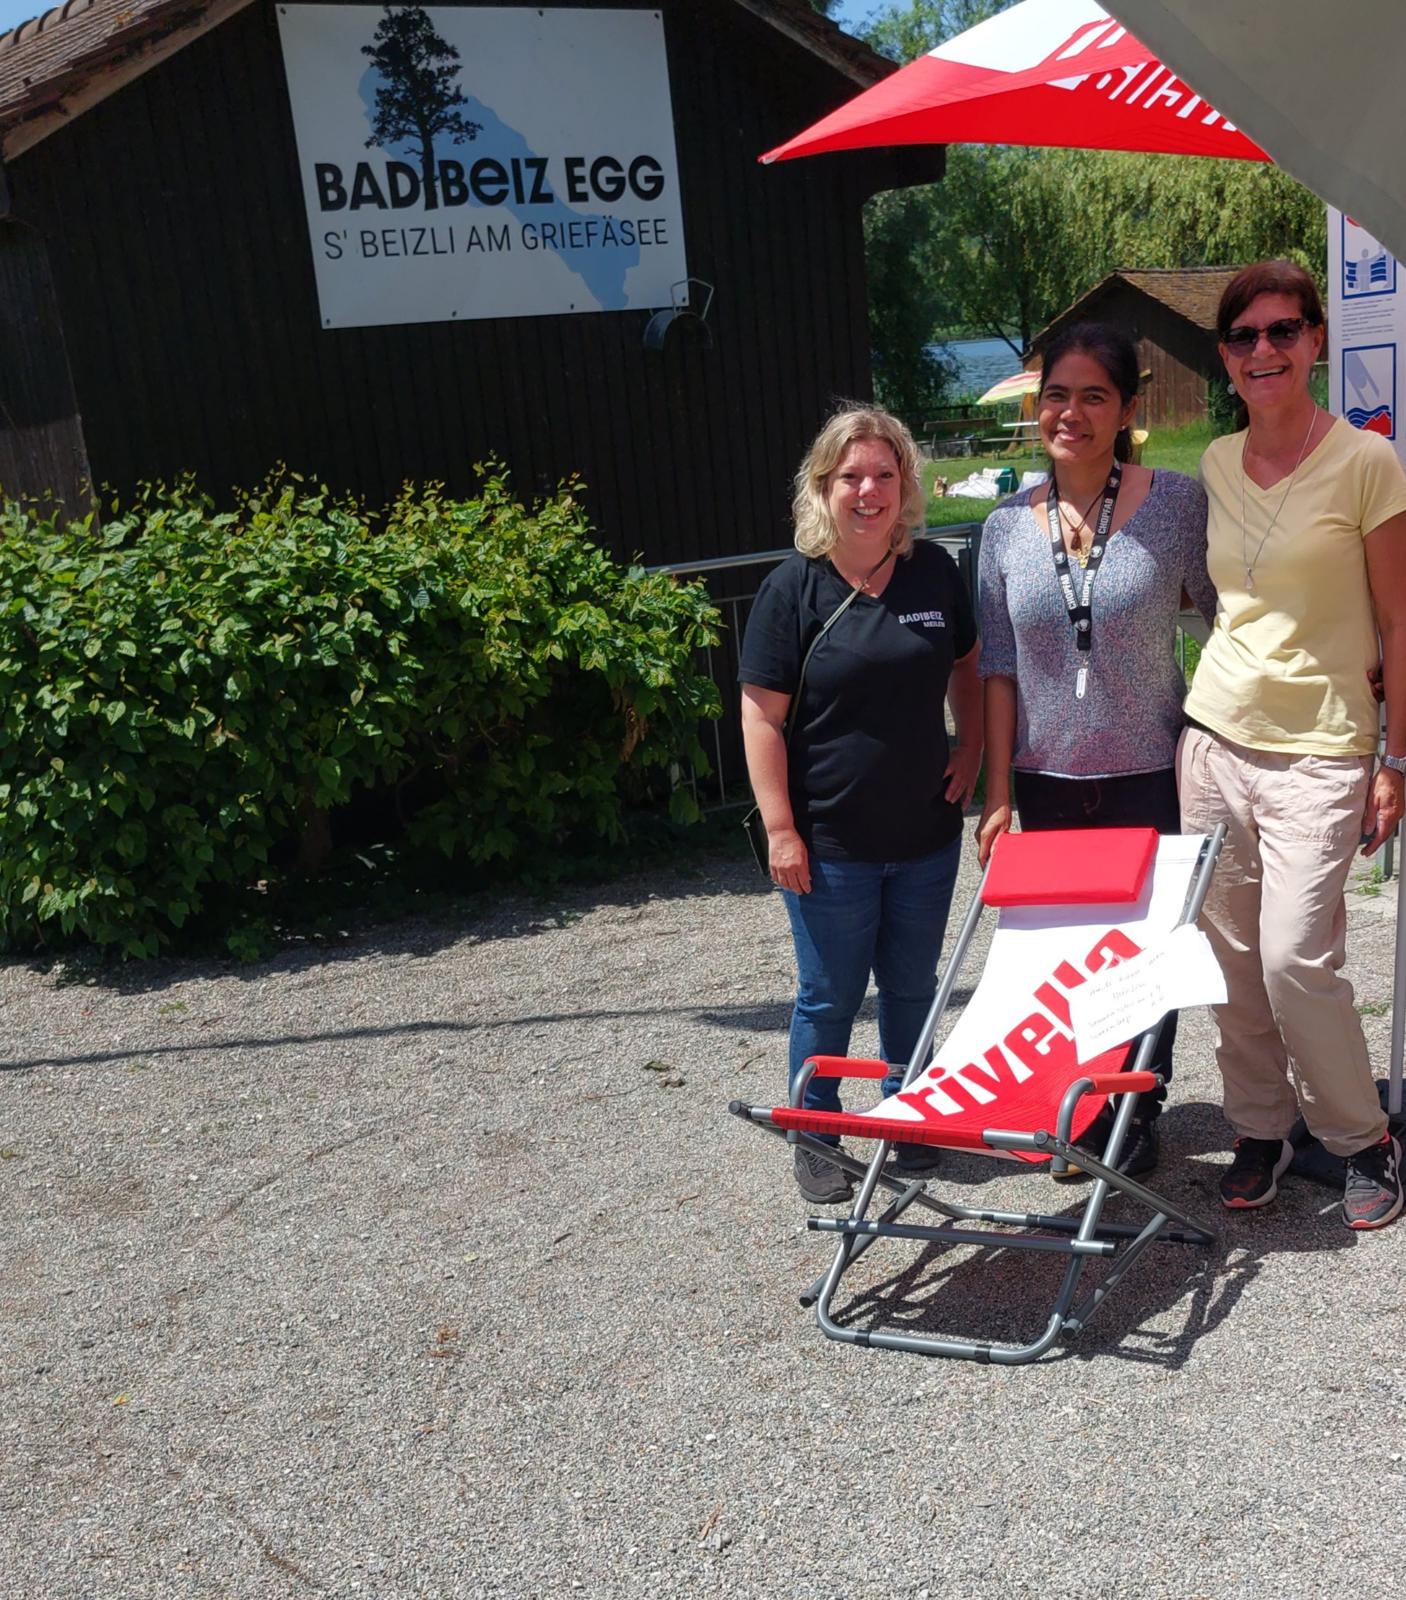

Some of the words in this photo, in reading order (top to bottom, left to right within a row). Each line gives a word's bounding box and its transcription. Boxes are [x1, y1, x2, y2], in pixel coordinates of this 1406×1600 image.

[564, 154, 665, 203] EGG
[360, 225, 456, 259] BEIZLI
[466, 224, 511, 253] AM
[521, 215, 669, 251] GRIEFÄSEE
[1098, 498, 1114, 535] CHOPFAB
[1060, 574, 1077, 610] CHOPFAB
[1081, 569, 1095, 607] CHOPFAB
[898, 611, 944, 624] BADIBEIZ
